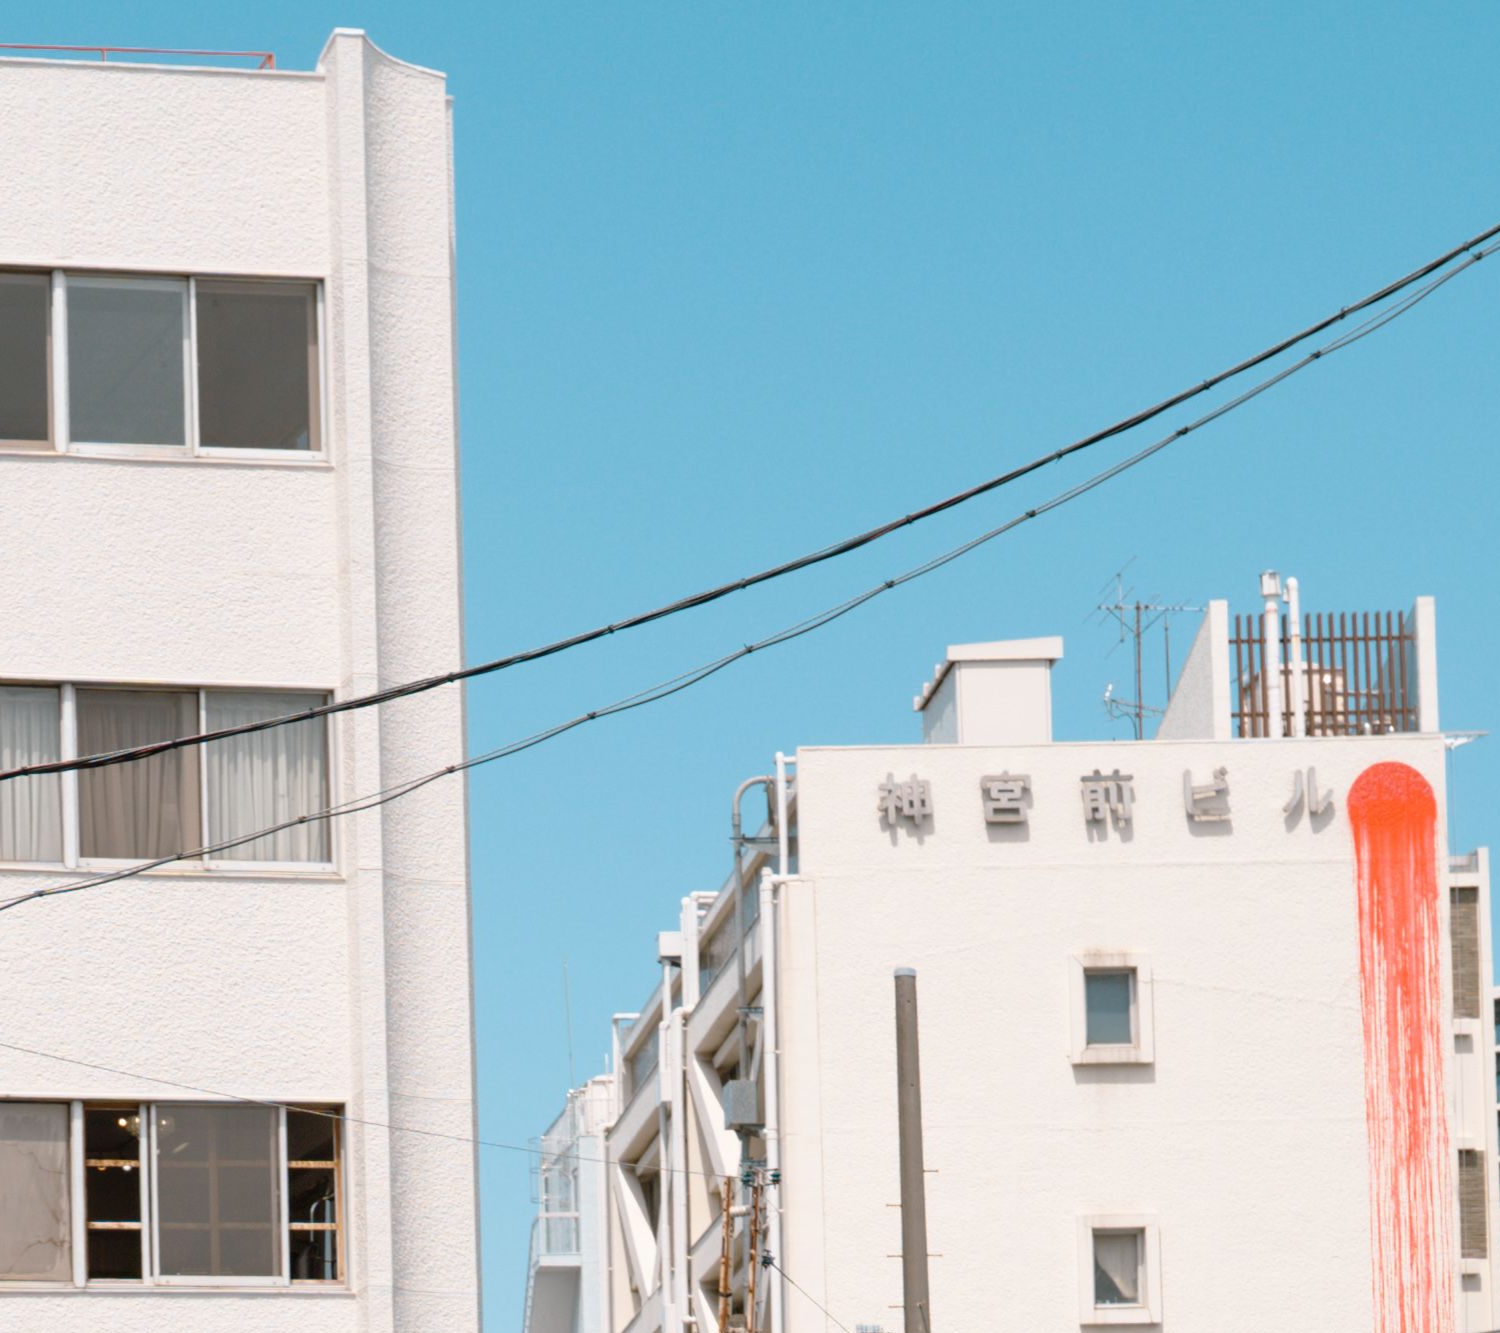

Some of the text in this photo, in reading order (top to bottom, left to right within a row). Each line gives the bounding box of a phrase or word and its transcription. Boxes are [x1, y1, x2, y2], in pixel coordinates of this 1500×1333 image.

[878, 767, 1335, 828] 神宮前ビル
